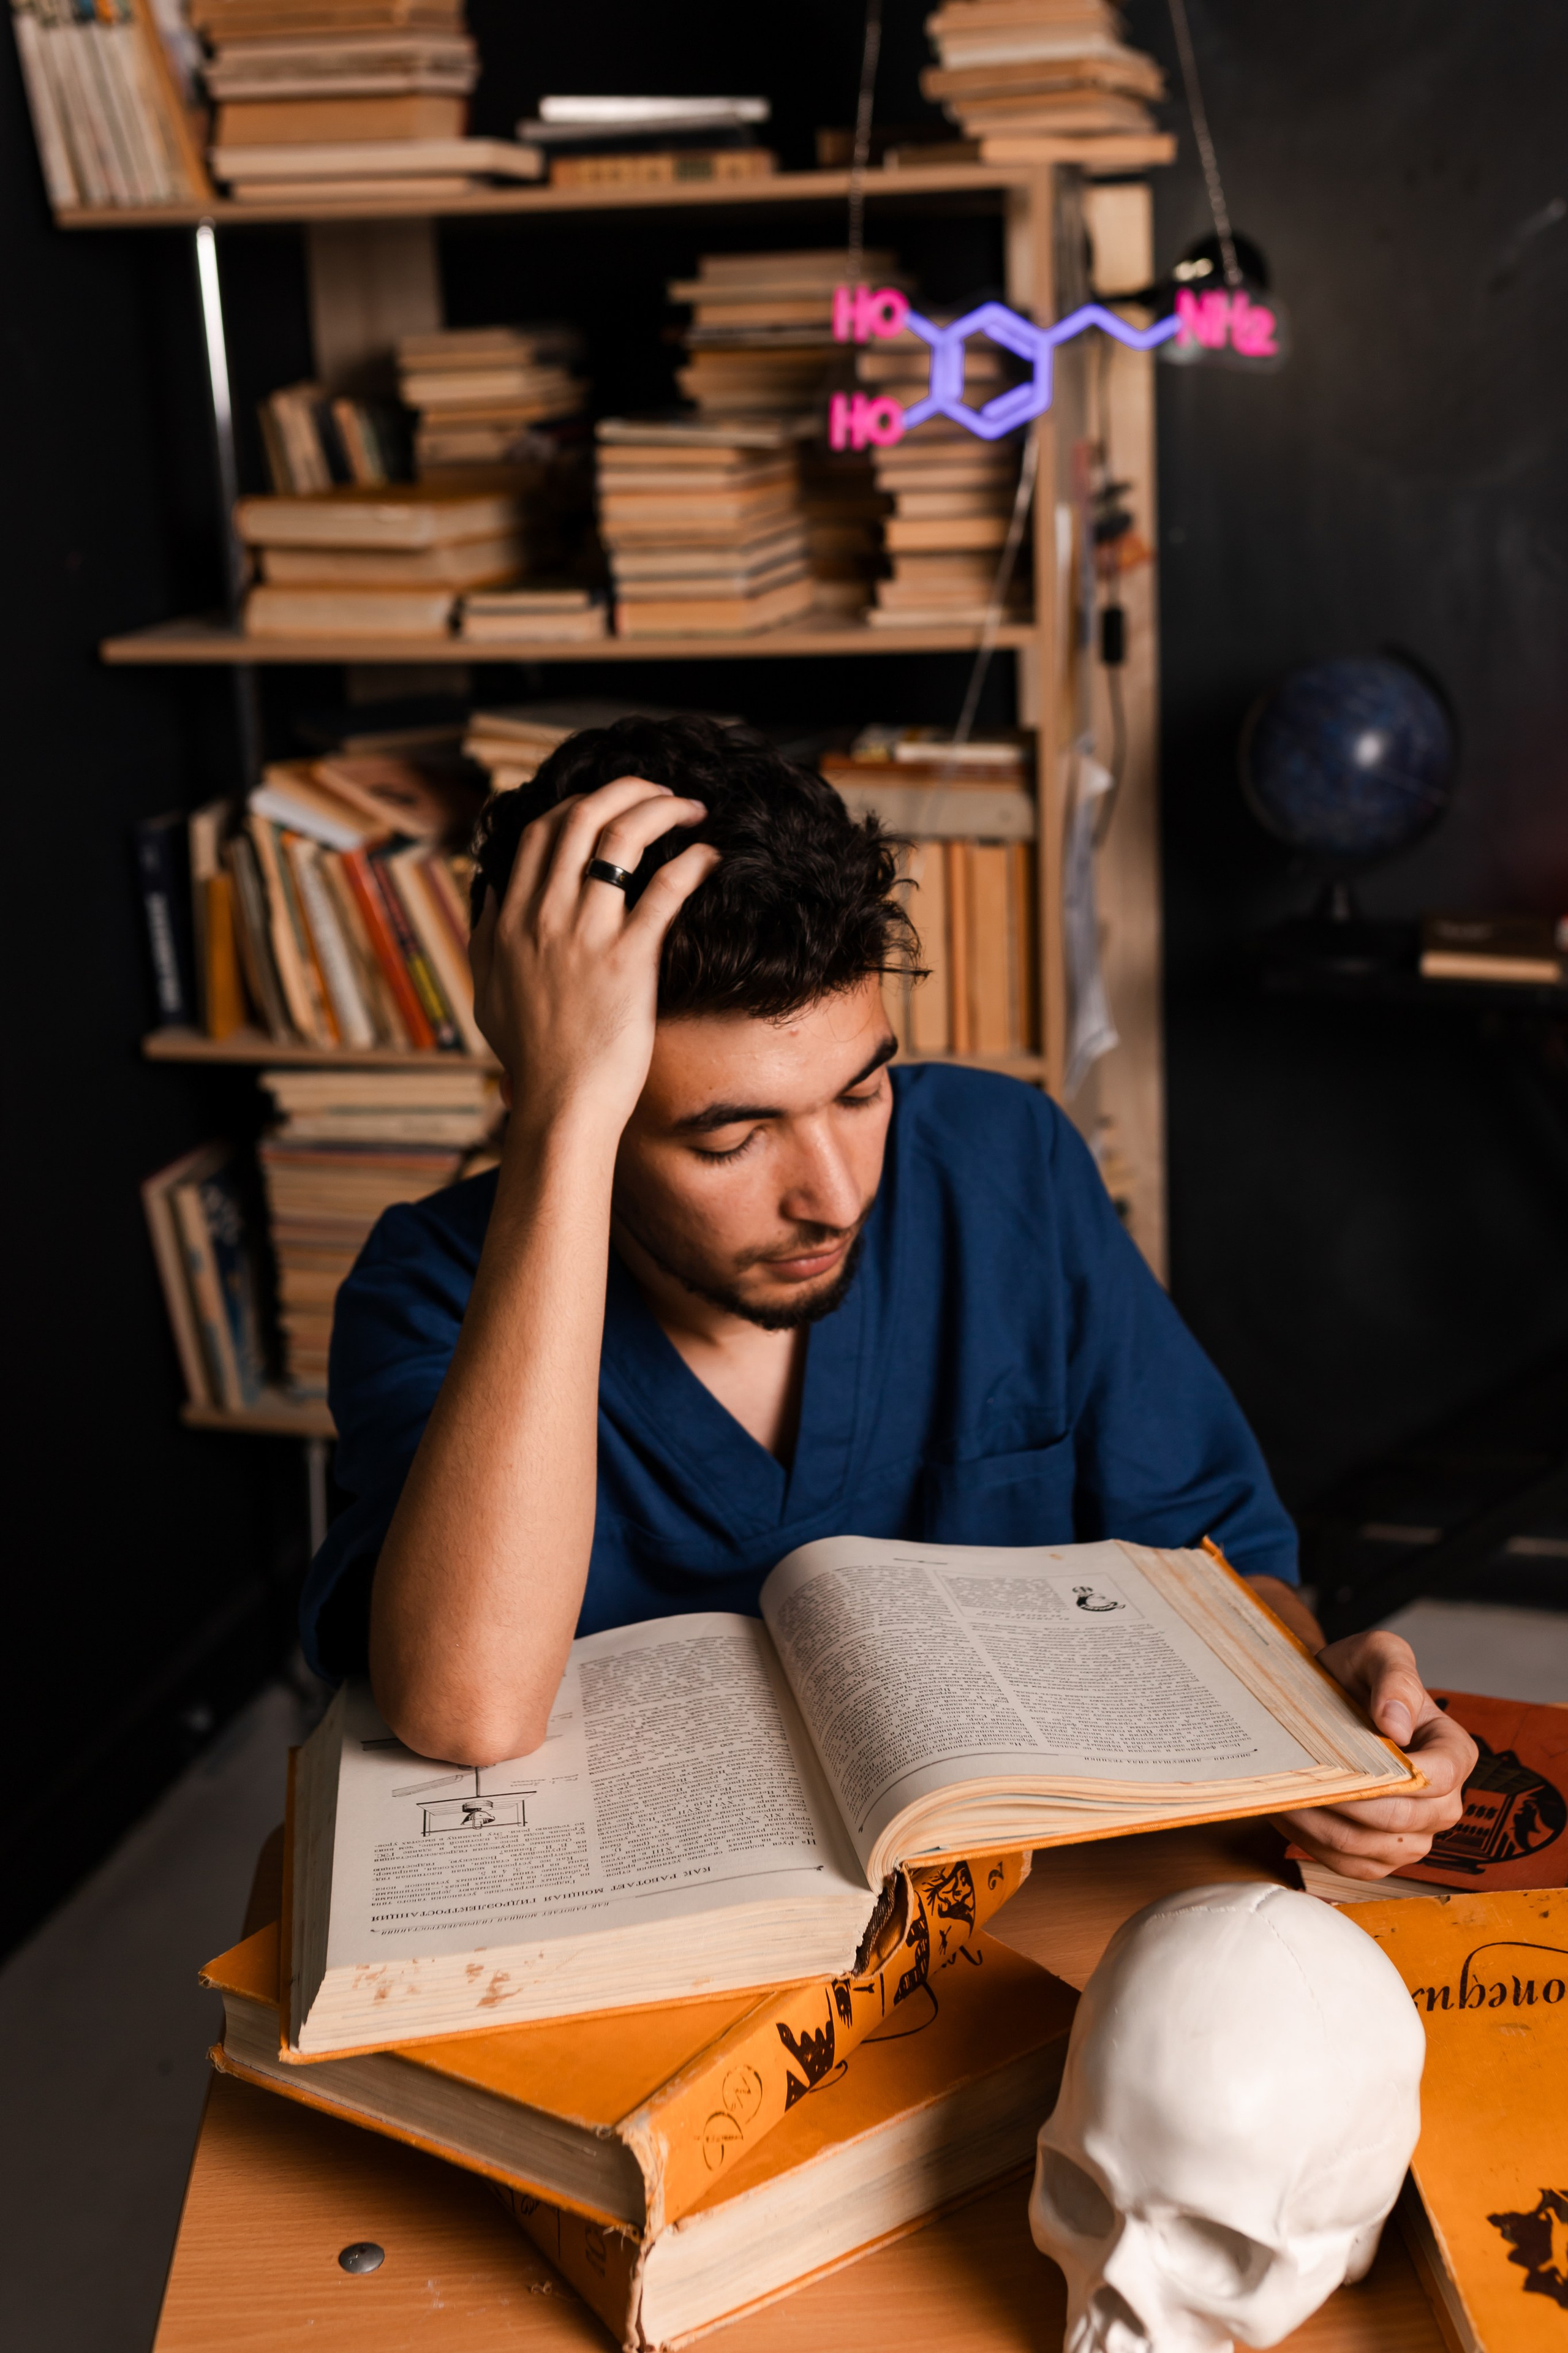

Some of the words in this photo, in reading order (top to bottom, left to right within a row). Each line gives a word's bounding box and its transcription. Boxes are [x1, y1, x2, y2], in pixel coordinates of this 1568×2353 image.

[832, 285, 908, 342] HO
[829, 393, 906, 450] HO
[682, 1865, 711, 1877] КАК
[609, 1873, 677, 1891] РАБОТАЕТ
[542, 1887, 605, 1902] МОЩНАЯ
